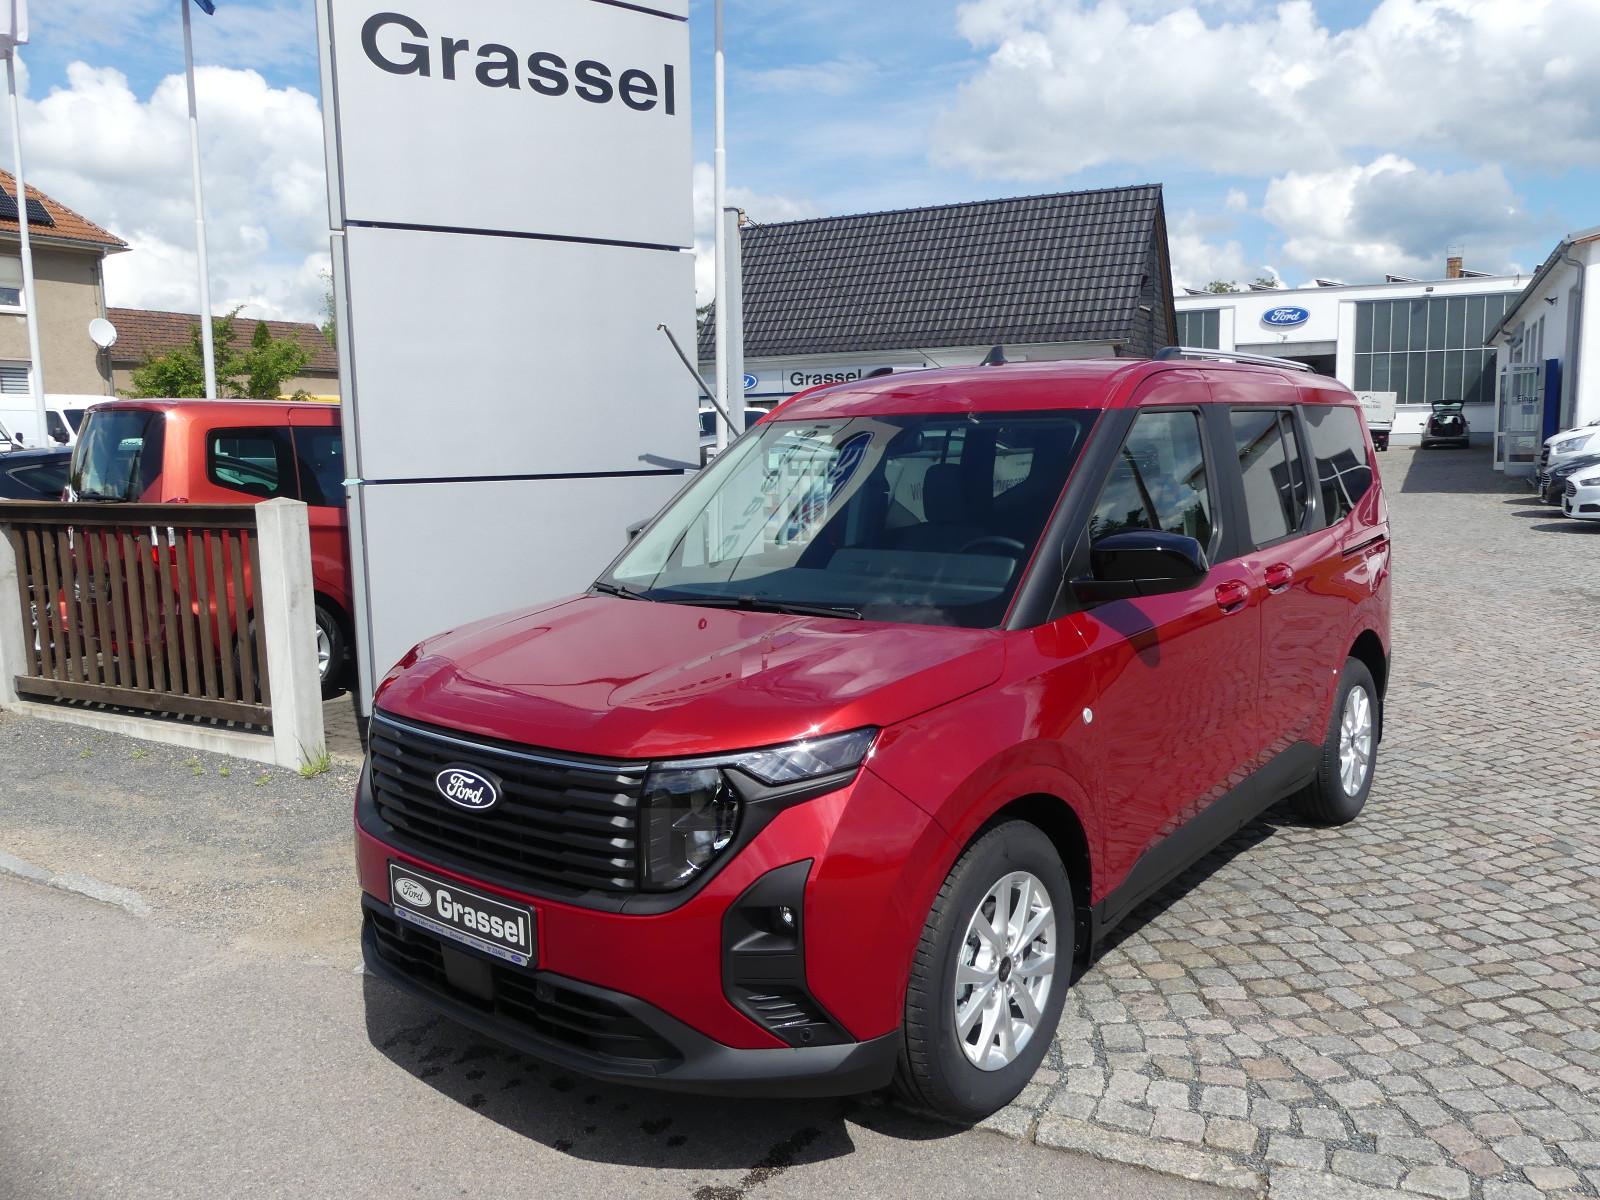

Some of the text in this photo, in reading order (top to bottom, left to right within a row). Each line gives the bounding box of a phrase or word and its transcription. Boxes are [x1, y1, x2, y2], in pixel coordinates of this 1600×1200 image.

[361, 12, 675, 116] Grassel
[1271, 308, 1301, 322] Ford
[790, 368, 862, 386] Grassel
[446, 773, 484, 804] Ford
[402, 881, 424, 902] Ford
[436, 889, 526, 947] Grassel
